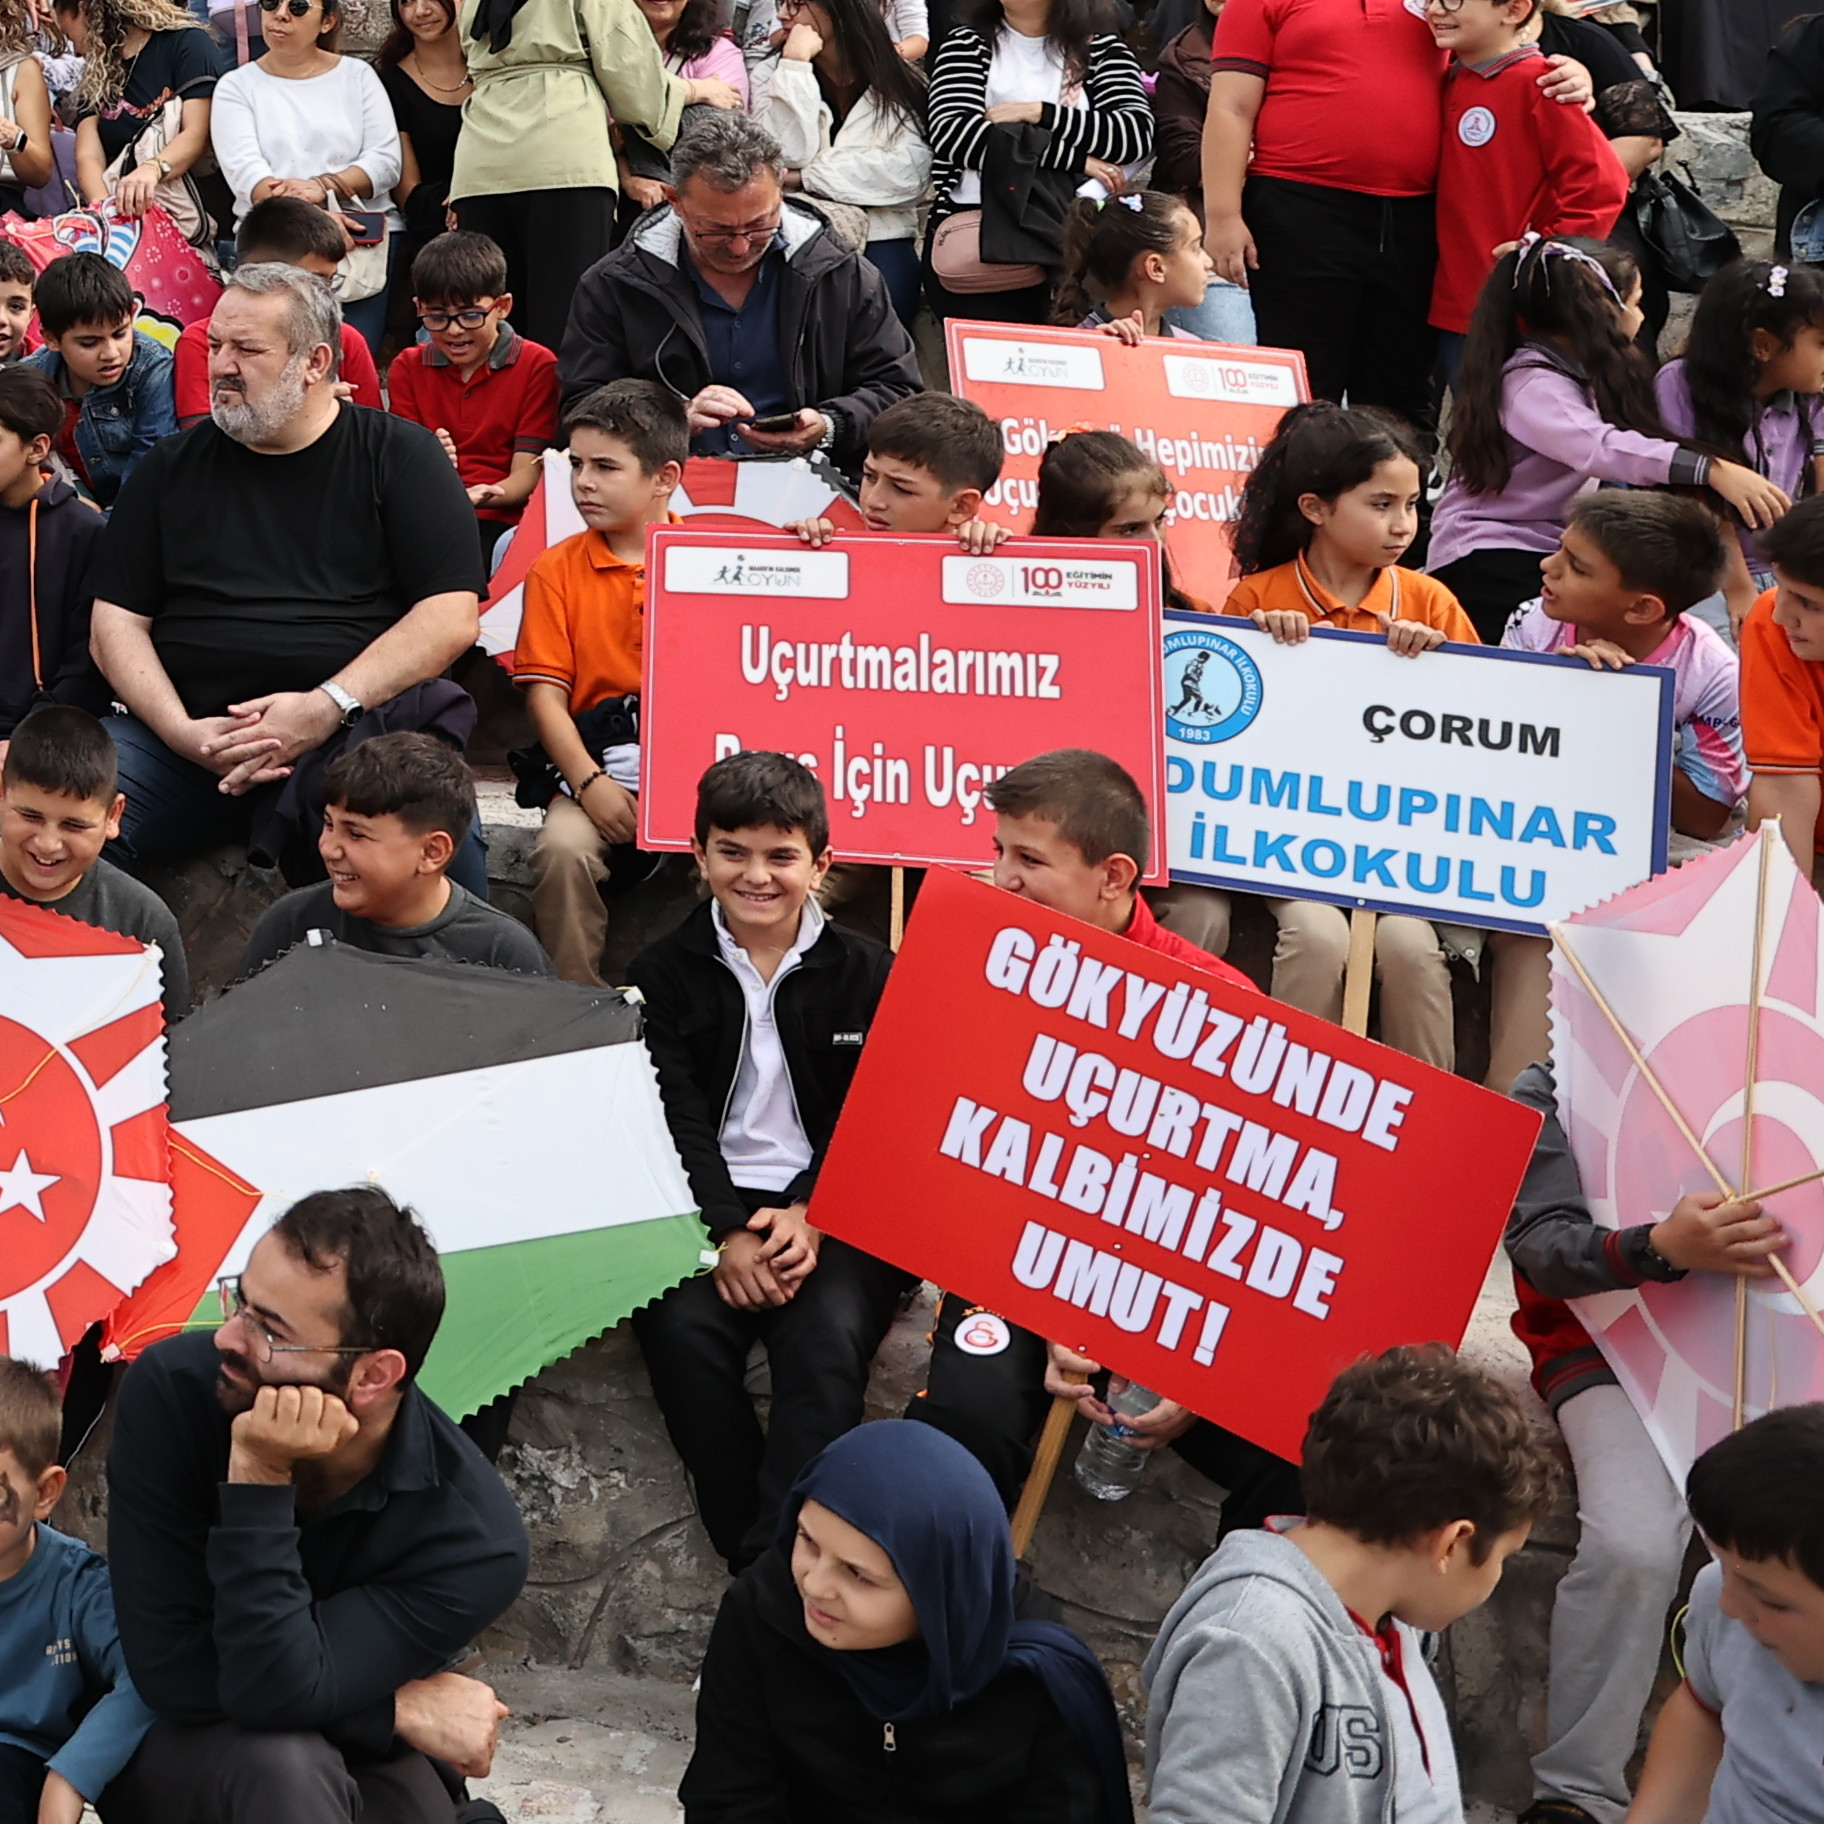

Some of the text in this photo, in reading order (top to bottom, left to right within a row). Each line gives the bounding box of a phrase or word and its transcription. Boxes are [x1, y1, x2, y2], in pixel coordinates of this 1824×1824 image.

[1020, 566, 1063, 594] 100
[740, 624, 1062, 701] Uçurtmalarımız
[832, 725, 910, 818] İçin
[1178, 727, 1210, 742] 1983
[1362, 704, 1561, 758] ÇORUM
[1166, 756, 1618, 856] DUMLUPINAR
[1189, 812, 1547, 909] İLKOKULU
[984, 926, 1415, 1153] GÖKYÜZÜNDE
[1021, 1032, 1345, 1232] UÇURTMA,
[938, 1095, 1346, 1321] KALBİMİZDE
[1010, 1220, 1232, 1368] UMUT!
